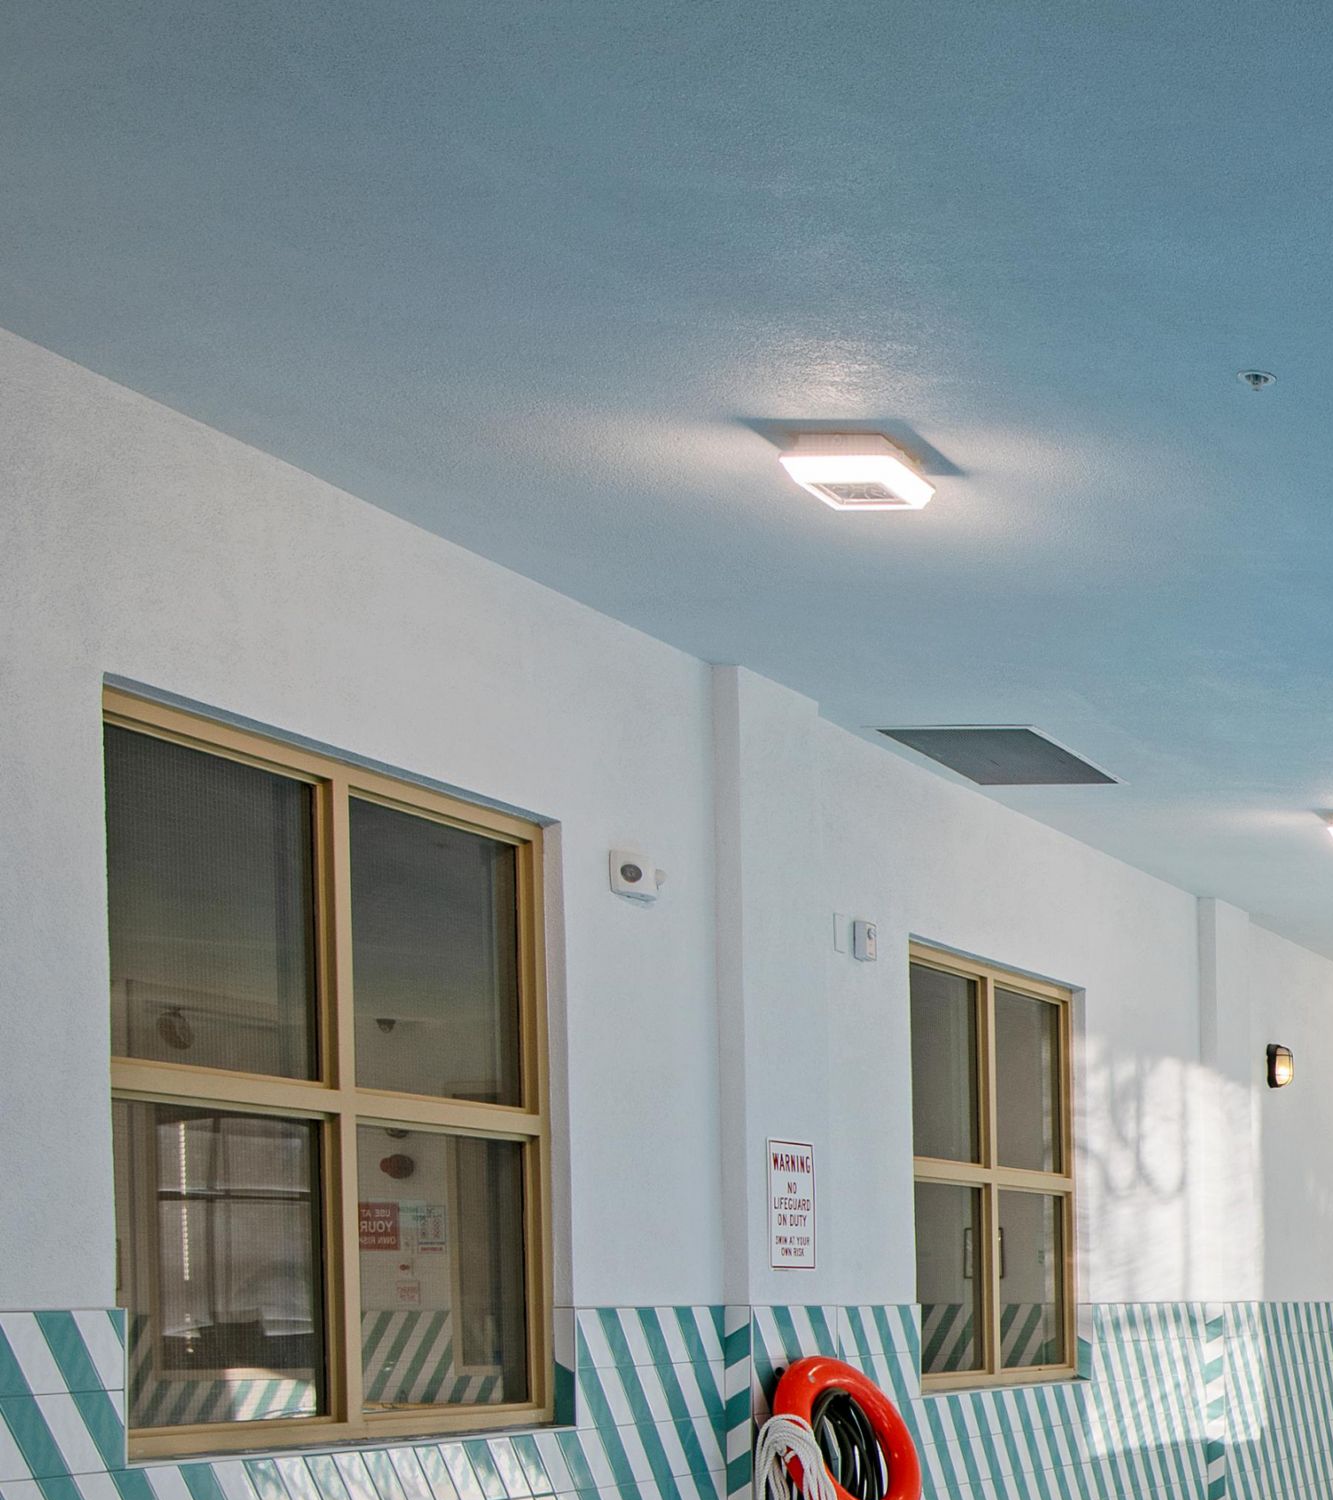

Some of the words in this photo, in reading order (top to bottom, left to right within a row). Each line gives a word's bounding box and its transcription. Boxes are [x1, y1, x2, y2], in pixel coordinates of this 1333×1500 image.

[772, 1152, 811, 1174] WARNING
[787, 1182, 797, 1194] NO
[773, 1197, 811, 1211] LIFEGUARD
[777, 1214, 788, 1226] ON
[789, 1214, 807, 1227] DUTY
